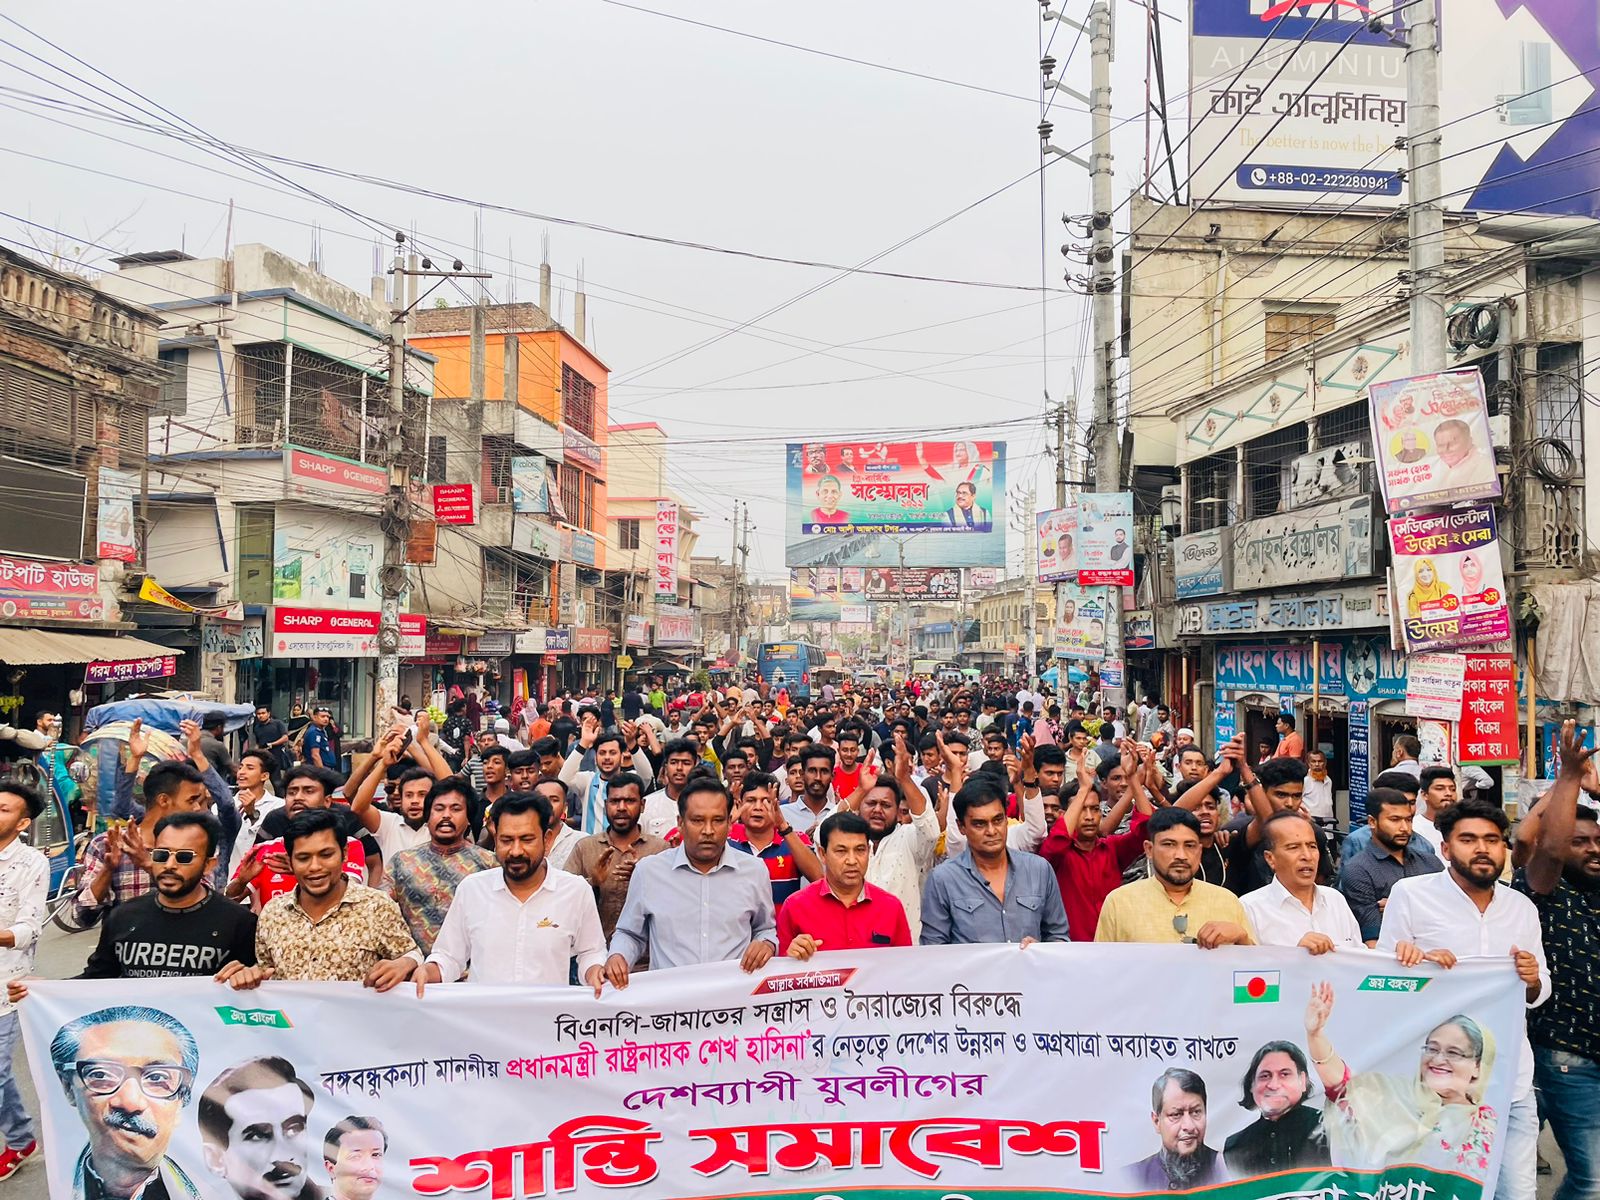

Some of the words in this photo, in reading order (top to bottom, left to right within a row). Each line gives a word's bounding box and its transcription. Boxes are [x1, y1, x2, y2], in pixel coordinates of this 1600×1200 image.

[1210, 46, 1400, 79] ALUMINIU
[1209, 84, 1262, 115] কাই
[1272, 91, 1408, 128] এ্যালুমিনিয়
[299, 459, 336, 474] SHARP
[851, 483, 929, 503] সম্মেলন
[0, 559, 47, 586] টপটি
[50, 567, 96, 591] হাউজ
[283, 615, 323, 625] SHARP
[1178, 605, 1202, 633] MB
[1408, 619, 1460, 640] উন্মেষ
[1217, 645, 1268, 682] মোহন
[1489, 658, 1512, 672] সকল
[1463, 680, 1487, 693] প্রকার
[1488, 680, 1510, 696] নতুন
[1469, 697, 1505, 715] সাইকেল
[1474, 717, 1501, 735] বিক্রয়
[1467, 742, 1487, 757] করা
[1487, 742, 1502, 757] হয়
[767, 979, 795, 992] আল্লাহ
[796, 971, 841, 989] সর্বশক্তিমান
[1367, 976, 1387, 992] জয়
[1388, 977, 1421, 994] বঙ্গবন্ধু
[229, 1008, 247, 1026] জয়
[248, 1009, 278, 1027] বাংলা
[555, 1005, 747, 1043] বিএনপি-জামাতের
[752, 997, 813, 1027] সন্ত্রাস
[820, 998, 837, 1020] ও
[843, 987, 943, 1021] নৈরাজ্যের
[951, 983, 1024, 1019] বিরুদ্ধে
[321, 1056, 428, 1100] বঙ্গবন্ধুকন্যা
[433, 1051, 500, 1086] মাননীয়
[506, 1040, 599, 1080] প্রধানমন্ত্রী
[605, 1036, 691, 1076] রাষ্ট্রনায়ক
[698, 1034, 739, 1065] শেখ
[831, 1029, 887, 1067] নেতৃত্বে
[896, 1029, 949, 1056] দেশের
[955, 1024, 1005, 1058] উন্নয়ন
[1012, 1033, 1027, 1051] ও
[1032, 1031, 1102, 1058] অগ্রযাত্রা
[1106, 1033, 1178, 1060] অব্যাহত
[1186, 1035, 1239, 1061] রাখতে
[623, 1065, 802, 1112] দেশব্যাপী
[813, 1066, 989, 1107] যুবলীগের
[409, 1114, 662, 1200] শান্তি
[689, 1117, 1107, 1179] সমাবেশ
